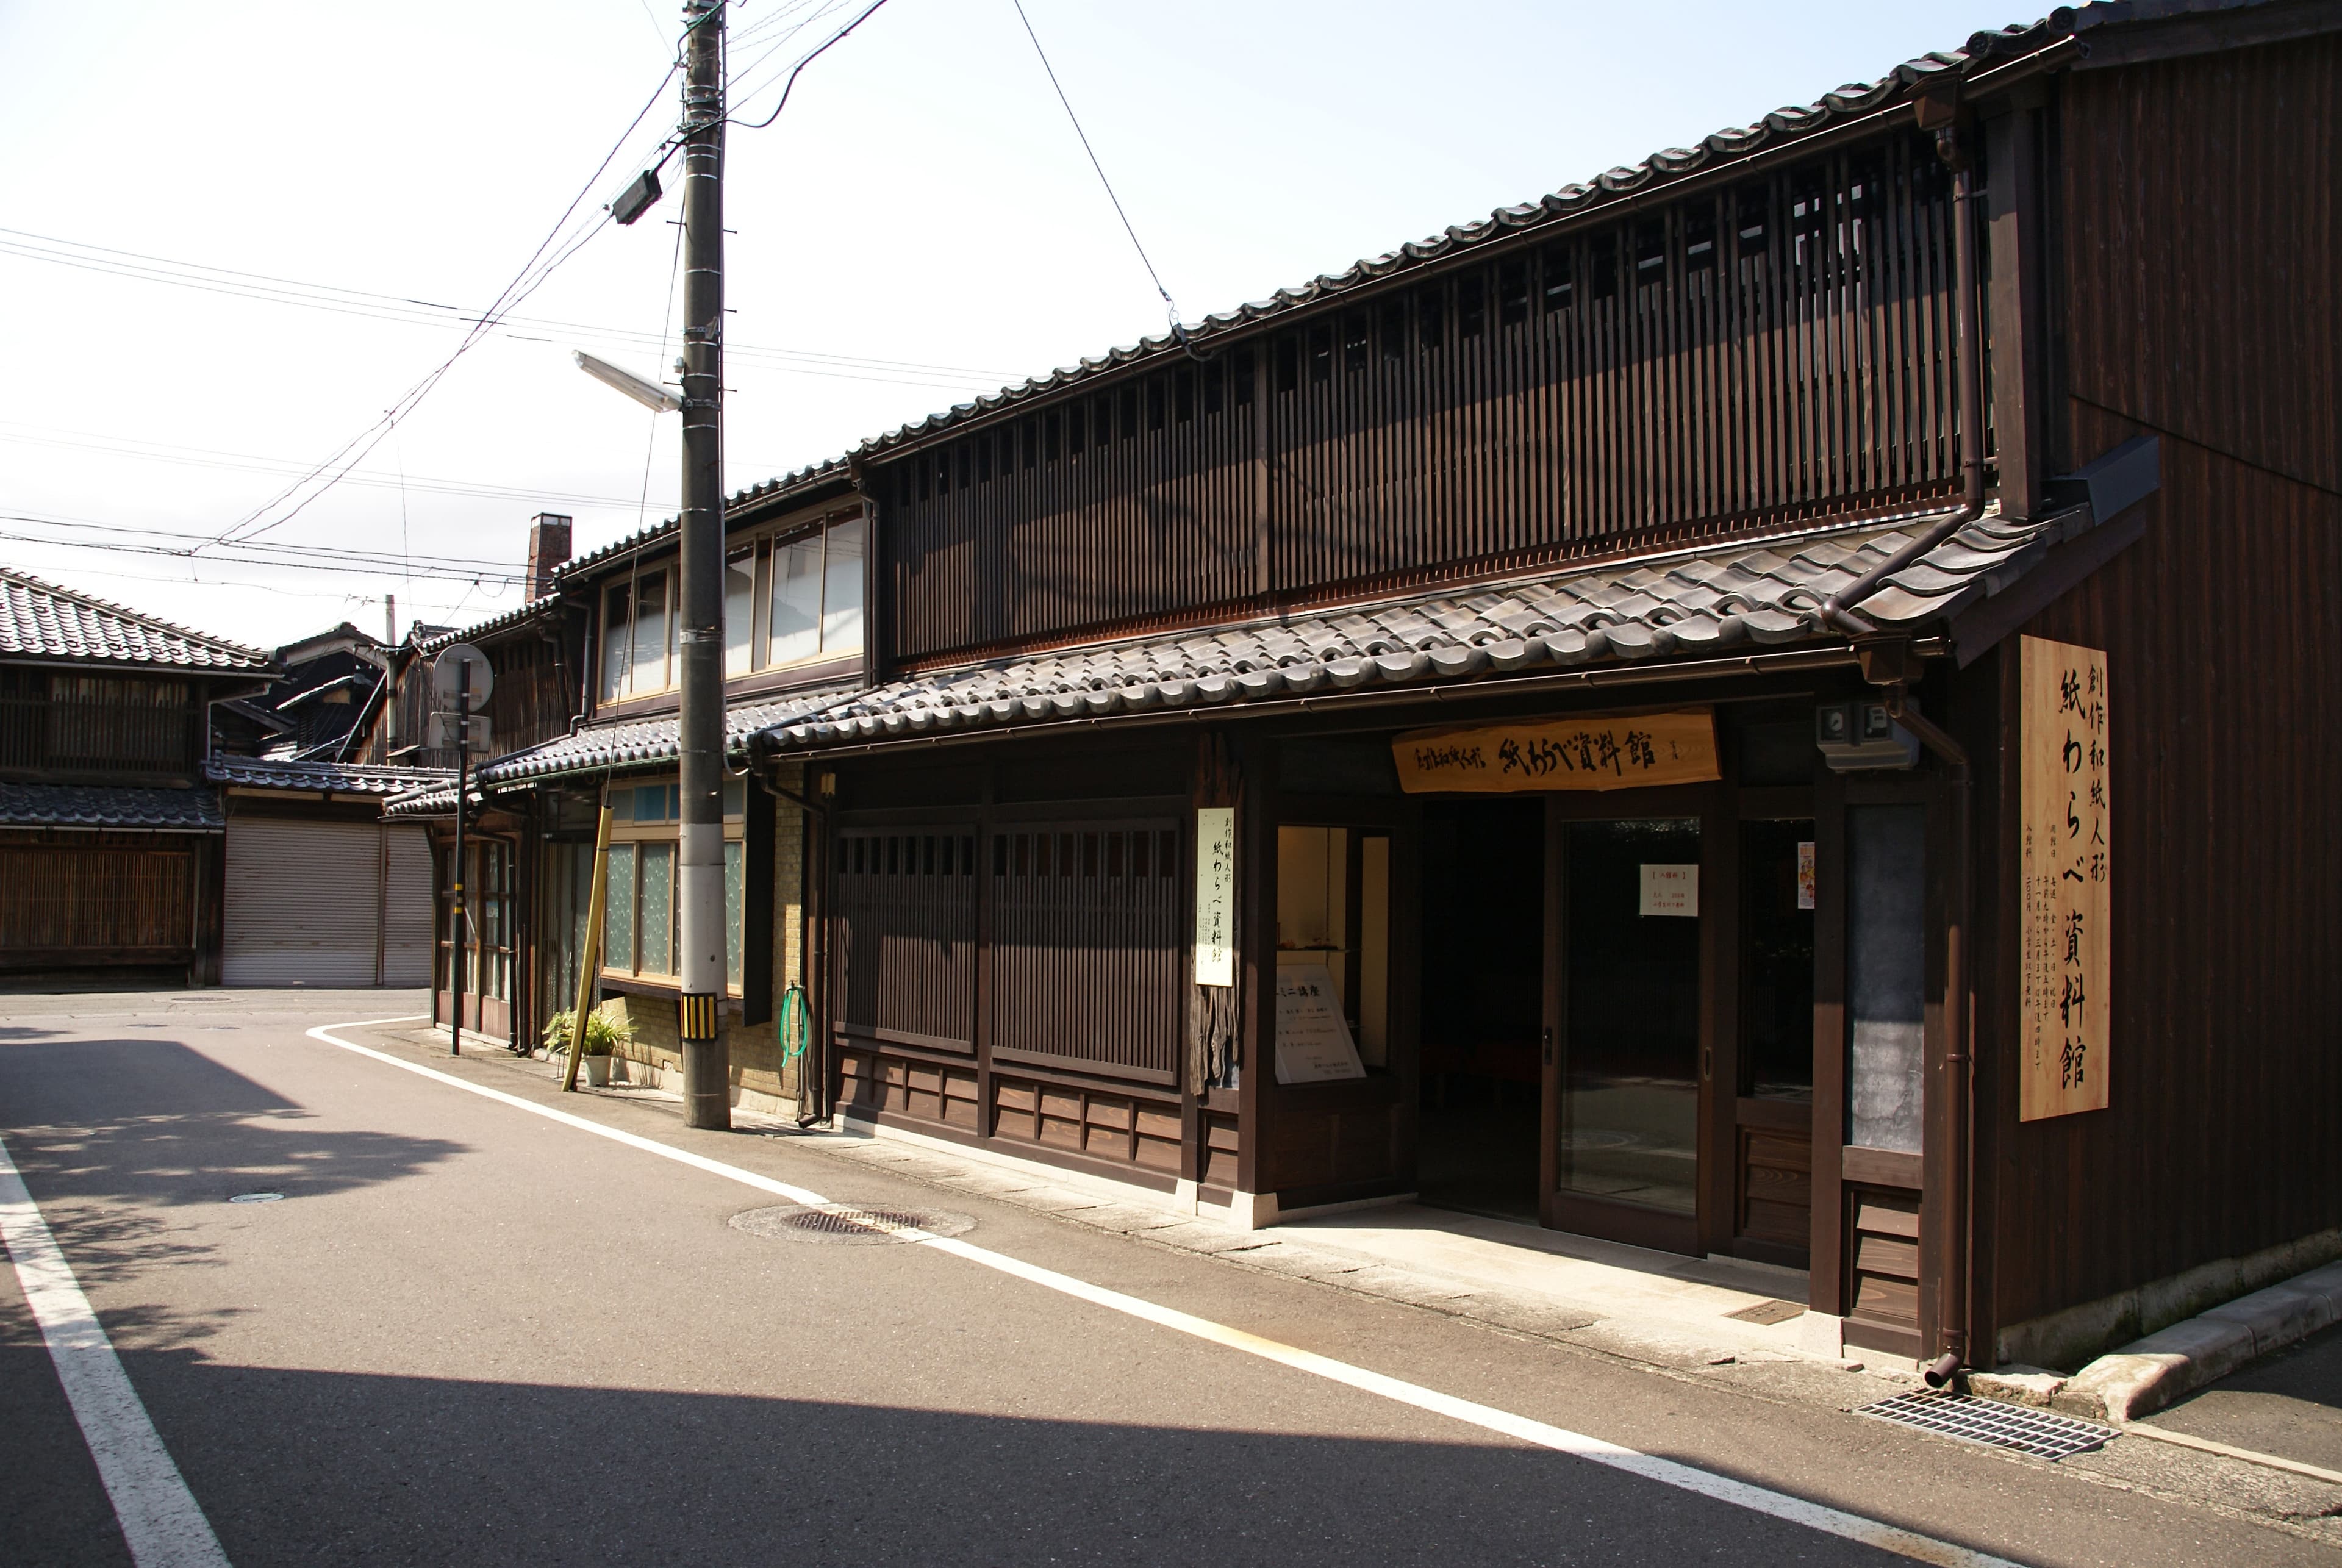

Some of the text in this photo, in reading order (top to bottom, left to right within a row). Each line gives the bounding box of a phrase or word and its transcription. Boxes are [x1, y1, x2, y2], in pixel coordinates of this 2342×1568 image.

[1498, 729, 1656, 777] 紙わらべ資料館
[2088, 664, 2106, 883] 創作和紙人形
[1223, 817, 1233, 883] 創作和紙人形
[2058, 668, 2086, 1090] 紙わらべ資料館
[1211, 840, 1223, 963] 紙わらべ資料館
[1276, 984, 1321, 998] ミニ講座
